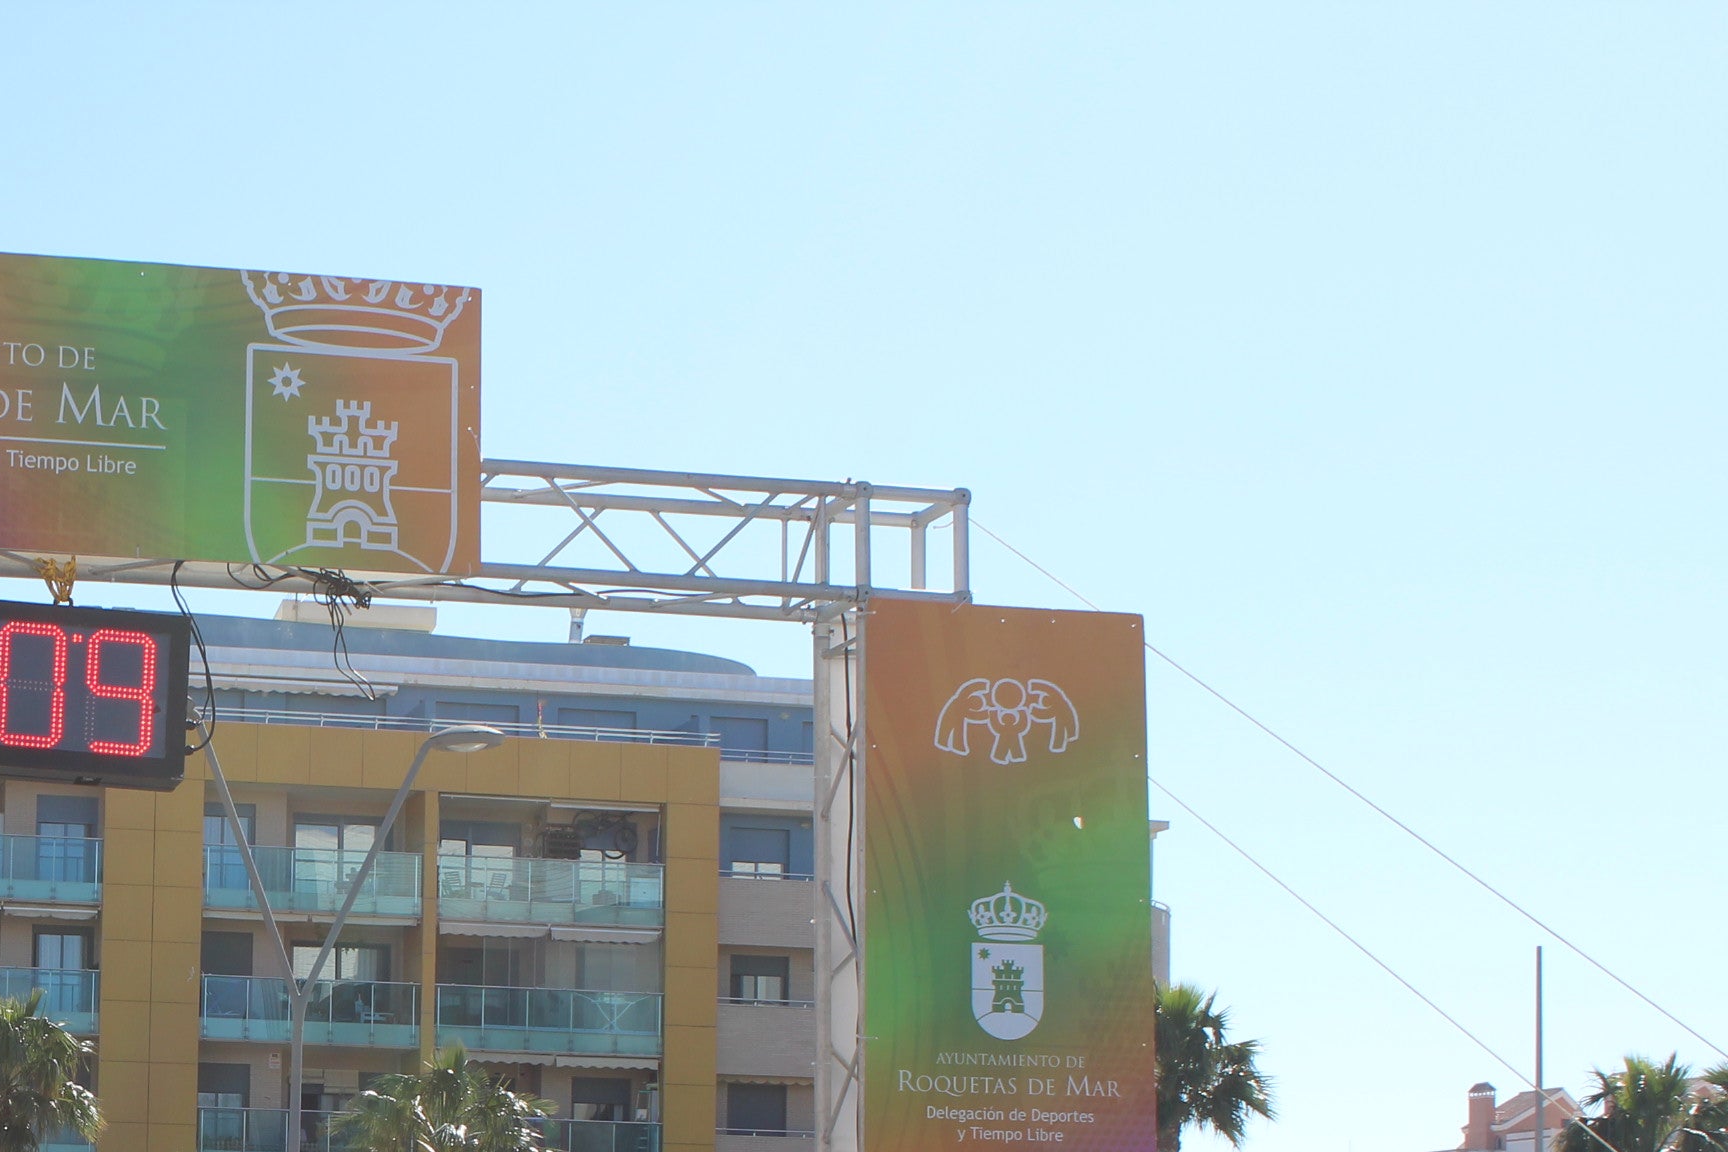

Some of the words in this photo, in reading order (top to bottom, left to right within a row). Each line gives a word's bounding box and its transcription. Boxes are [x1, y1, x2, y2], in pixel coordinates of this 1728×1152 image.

[58, 345, 96, 371] DE
[6, 449, 79, 475] Tiempo
[86, 455, 137, 475] Libre
[935, 1052, 1061, 1068] AYUNTAMIENTO
[1066, 1055, 1085, 1069] DE
[1028, 1078, 1055, 1096] DE
[926, 1105, 1004, 1122] Delegación
[1009, 1107, 1026, 1122] de
[1031, 1108, 1094, 1125] Deportes
[957, 1128, 966, 1142] y
[970, 1126, 1022, 1144] Tiempo
[1027, 1128, 1063, 1142] Libre
